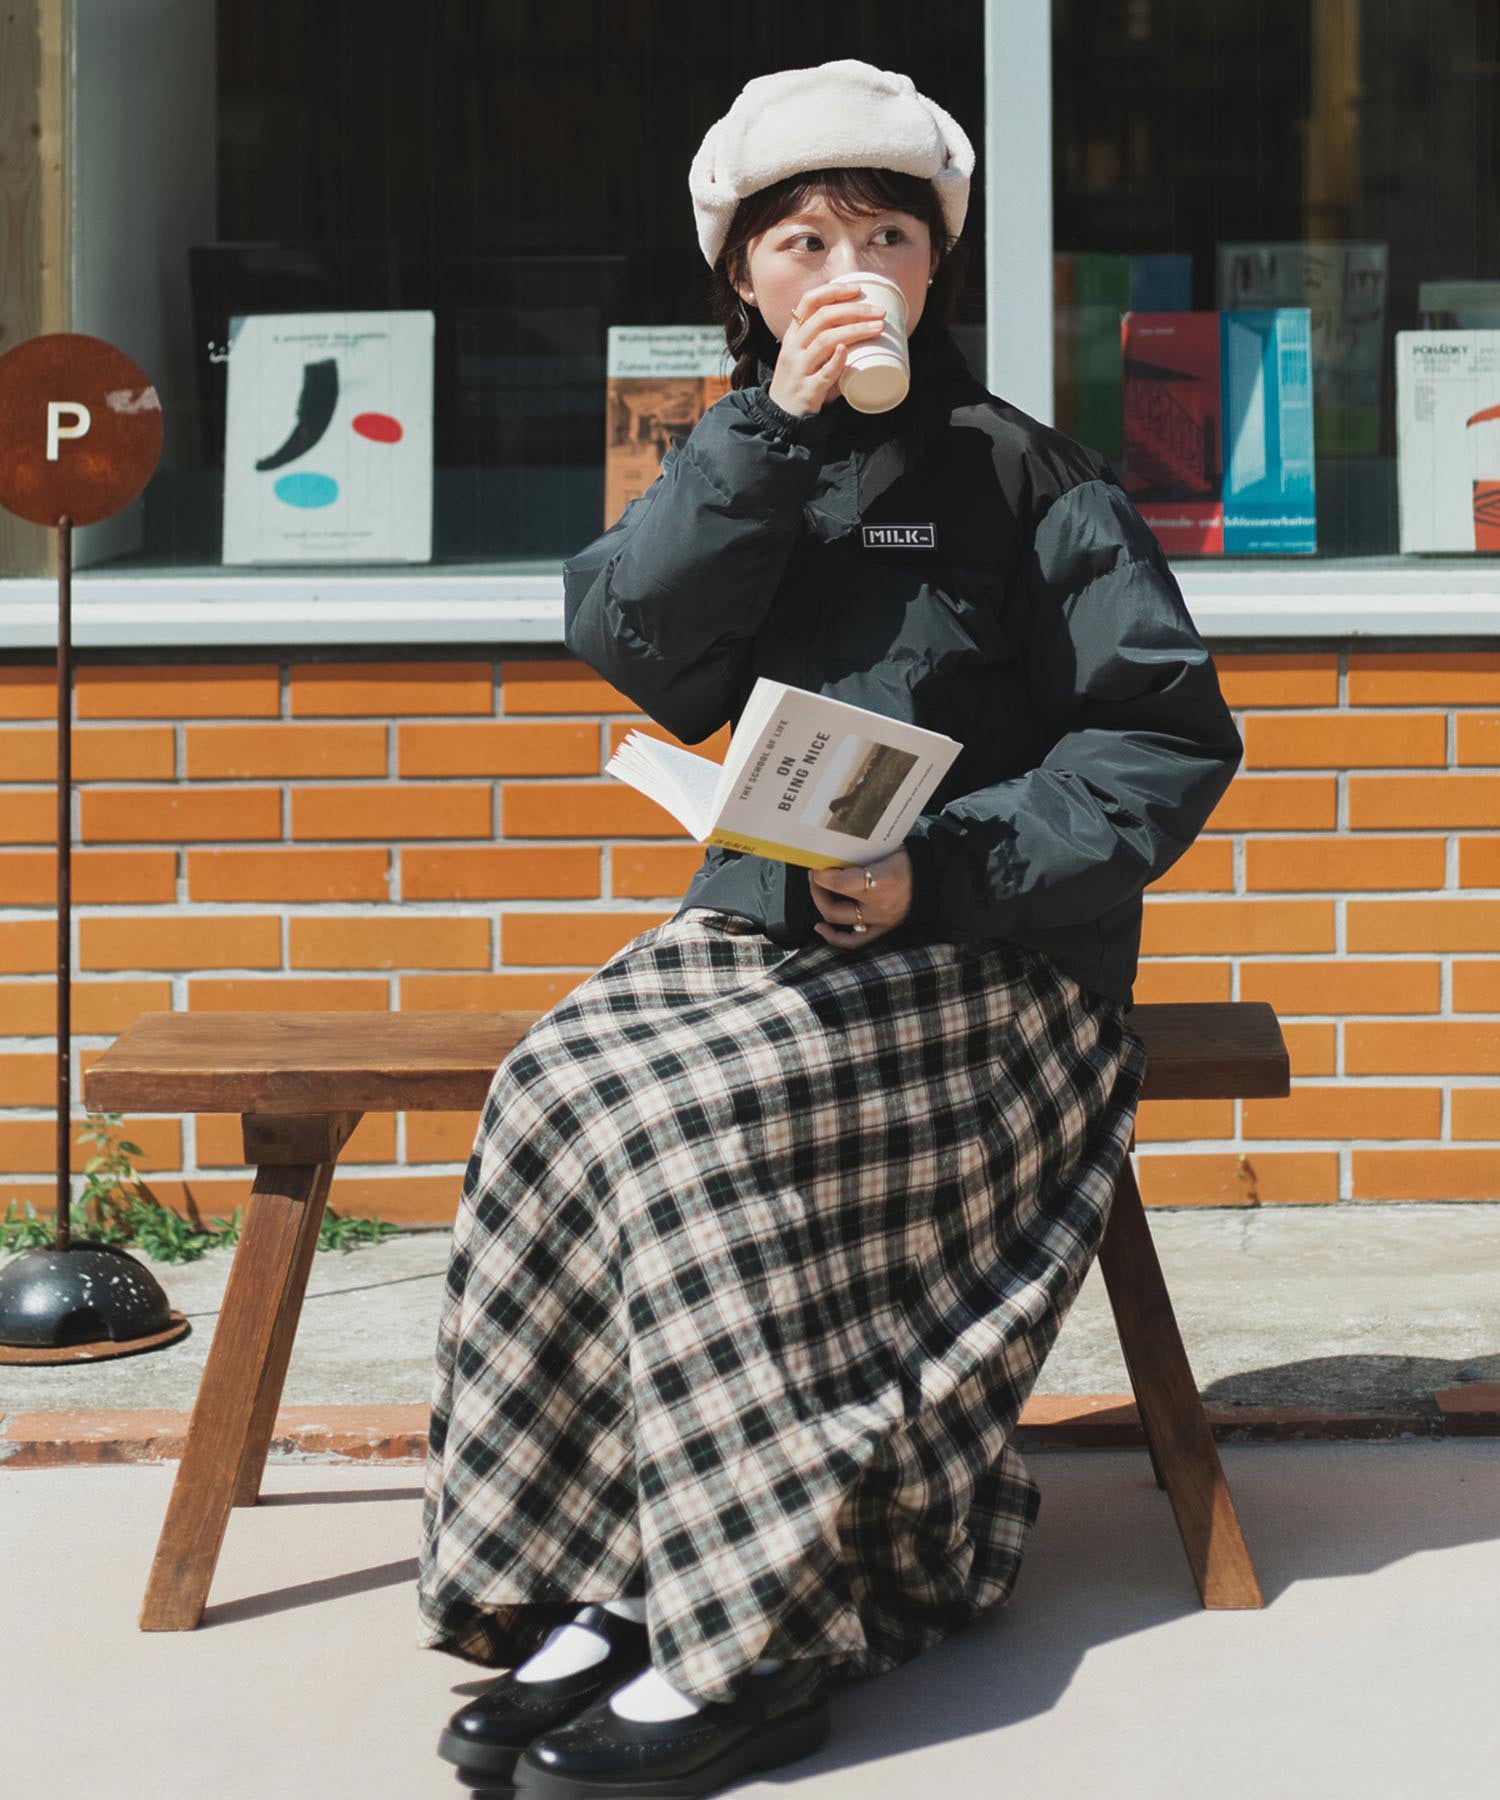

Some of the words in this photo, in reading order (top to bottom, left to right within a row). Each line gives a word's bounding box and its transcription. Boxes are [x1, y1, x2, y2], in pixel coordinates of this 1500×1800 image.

[47, 401, 91, 461] P
[739, 785, 754, 800] THE
[749, 752, 771, 783] SCHOOL
[766, 739, 776, 750] OF
[773, 719, 789, 738] LIFE
[776, 756, 796, 776] ON
[777, 768, 810, 812] BEING
[802, 731, 831, 765] NICE
